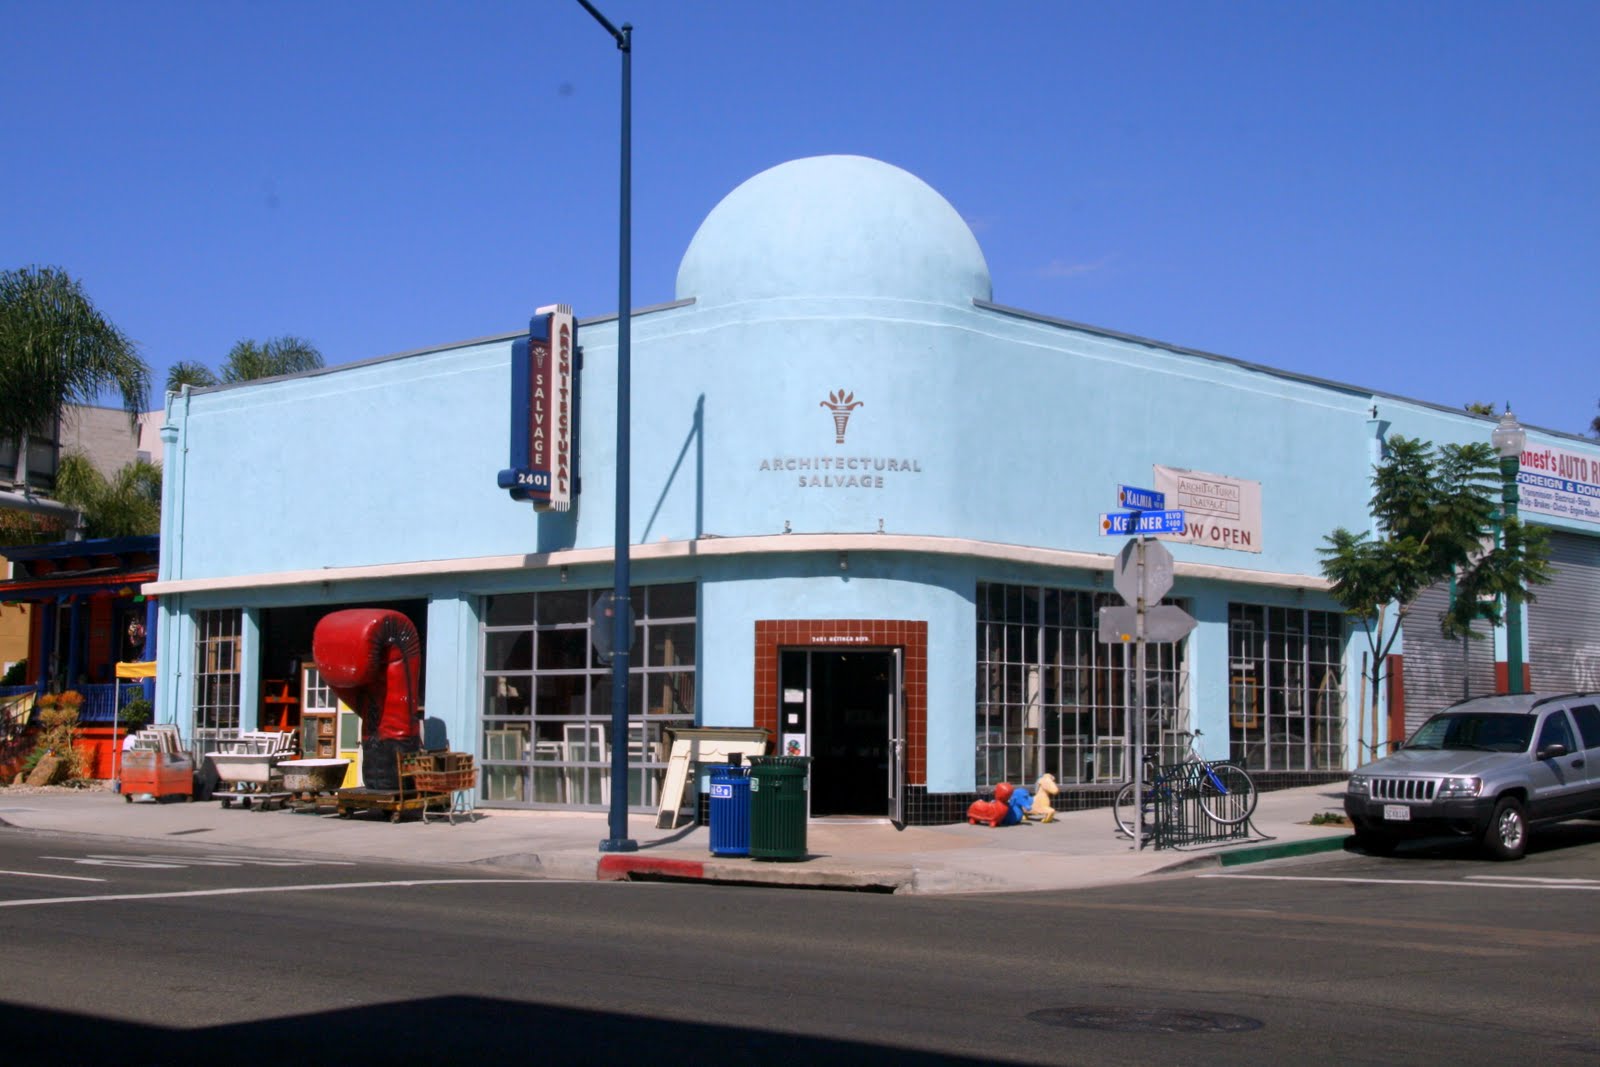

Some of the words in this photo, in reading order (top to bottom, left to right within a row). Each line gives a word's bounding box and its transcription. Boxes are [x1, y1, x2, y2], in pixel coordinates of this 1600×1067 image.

[557, 323, 570, 493] ARCHITECTURAL
[533, 374, 544, 465] SALVAGE
[759, 457, 922, 473] ARCHITECTURAL
[1558, 454, 1588, 482] AUTO
[518, 473, 548, 486] 2401
[799, 475, 884, 489] SALVAGE
[1516, 472, 1563, 490] FOREIGN
[1566, 482, 1574, 492] &
[1165, 520, 1181, 528] 2400
[1172, 523, 1204, 539] OW
[1211, 525, 1251, 545] OPEN
